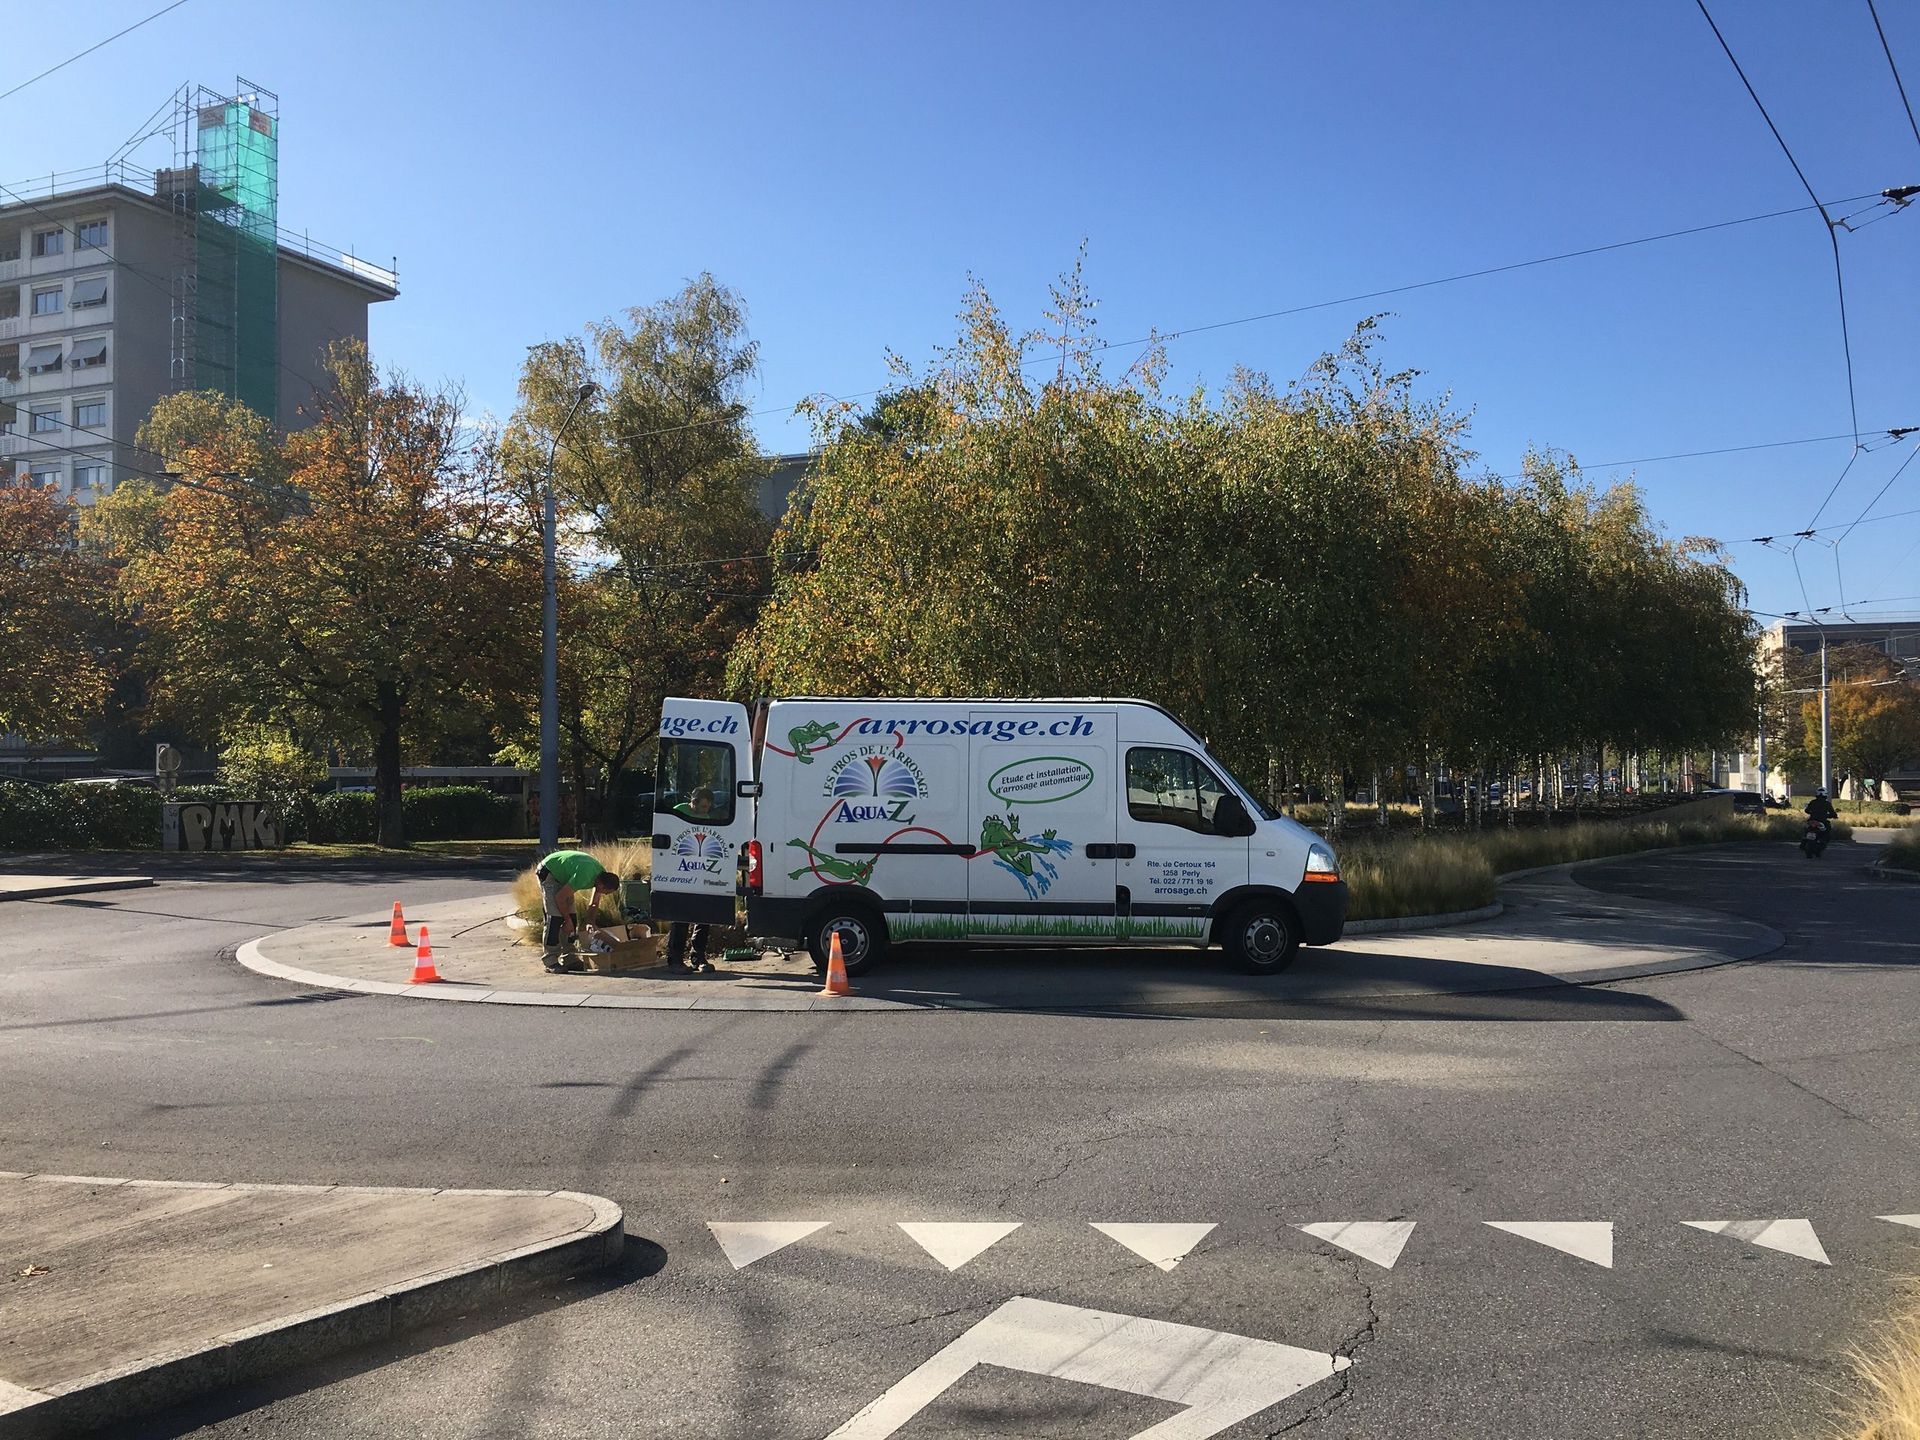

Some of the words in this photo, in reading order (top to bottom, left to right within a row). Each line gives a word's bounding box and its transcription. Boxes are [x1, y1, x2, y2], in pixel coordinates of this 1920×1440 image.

[858, 714, 1095, 741] arrosage.ch
[822, 775, 836, 798] LES
[831, 750, 858, 775] PROS
[859, 745, 876, 757] DE
[879, 745, 929, 800] L'ARROSAGE
[1001, 774, 1024, 785] Etude
[1025, 772, 1035, 781] et
[1036, 765, 1082, 779] installation
[995, 780, 1038, 795] d'arrosage
[1039, 772, 1091, 787] automatique
[1162, 860, 1172, 868] de
[1173, 860, 1202, 868] Certoux
[1182, 869, 1201, 878] Perly
[1154, 886, 1208, 896] arrosage.ch
